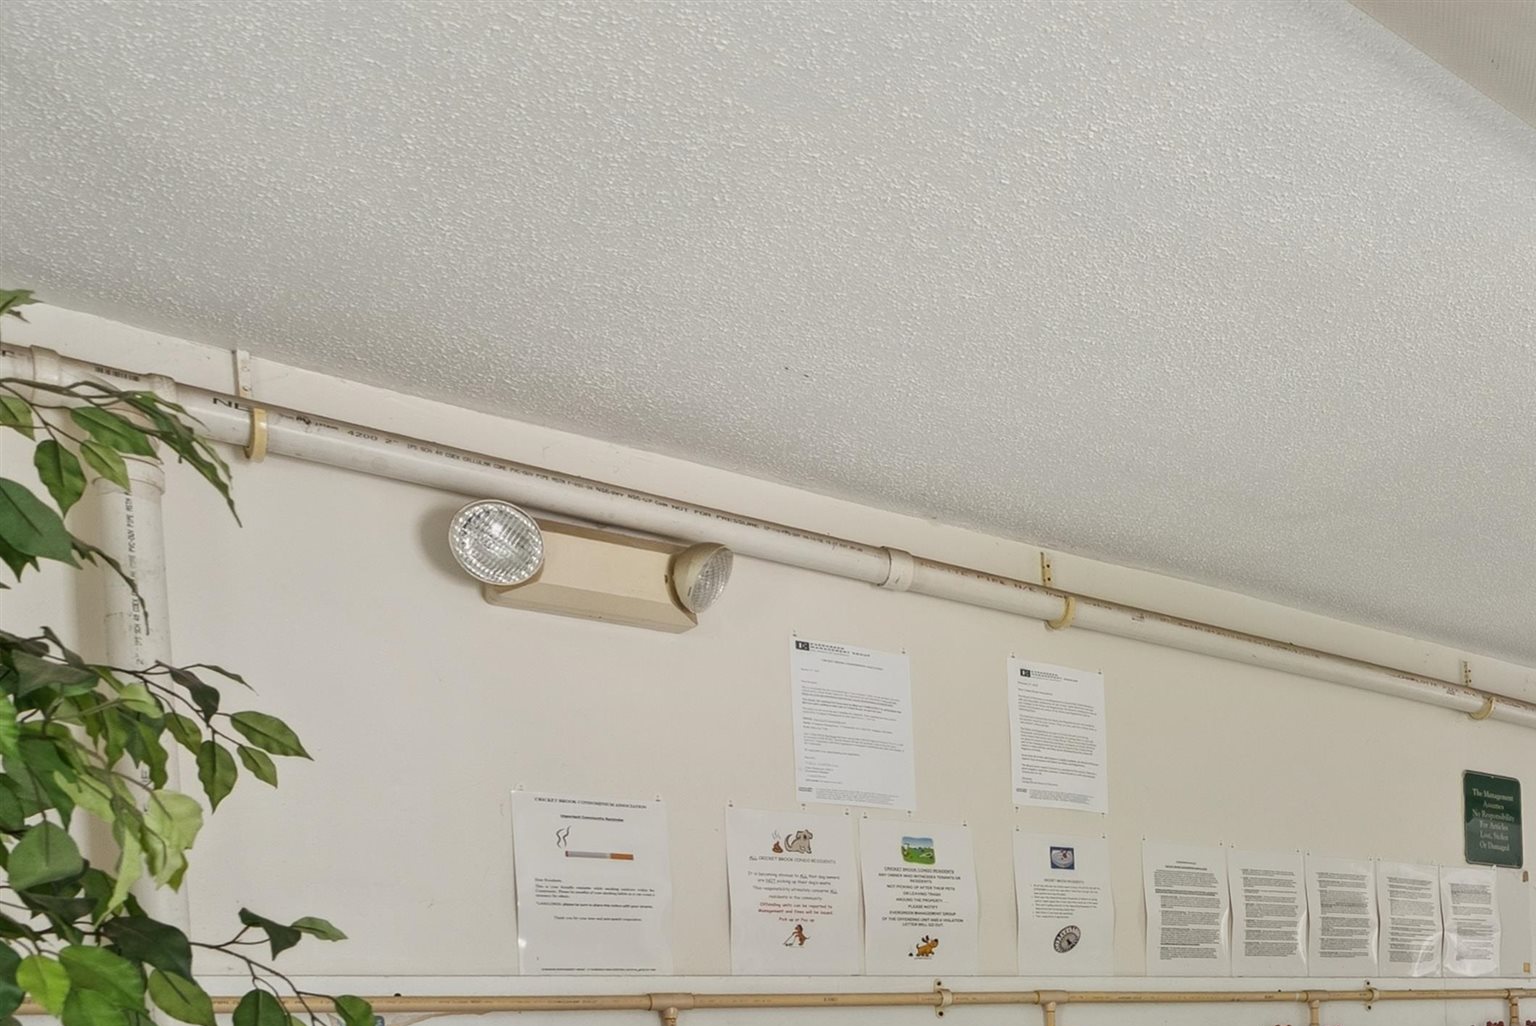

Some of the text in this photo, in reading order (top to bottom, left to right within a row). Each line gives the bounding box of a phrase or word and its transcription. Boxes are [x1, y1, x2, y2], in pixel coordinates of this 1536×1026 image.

[347, 429, 378, 441] 4200
[694, 509, 711, 517] FOR
[716, 515, 760, 529] PRESSURE
[1472, 788, 1514, 801] The Management
[1483, 800, 1504, 809] Assumes
[1472, 809, 1514, 822] No Responsibility
[1480, 820, 1508, 831] For Articles
[1494, 831, 1508, 840] Stolen
[1480, 840, 1509, 852] Or Damaged
